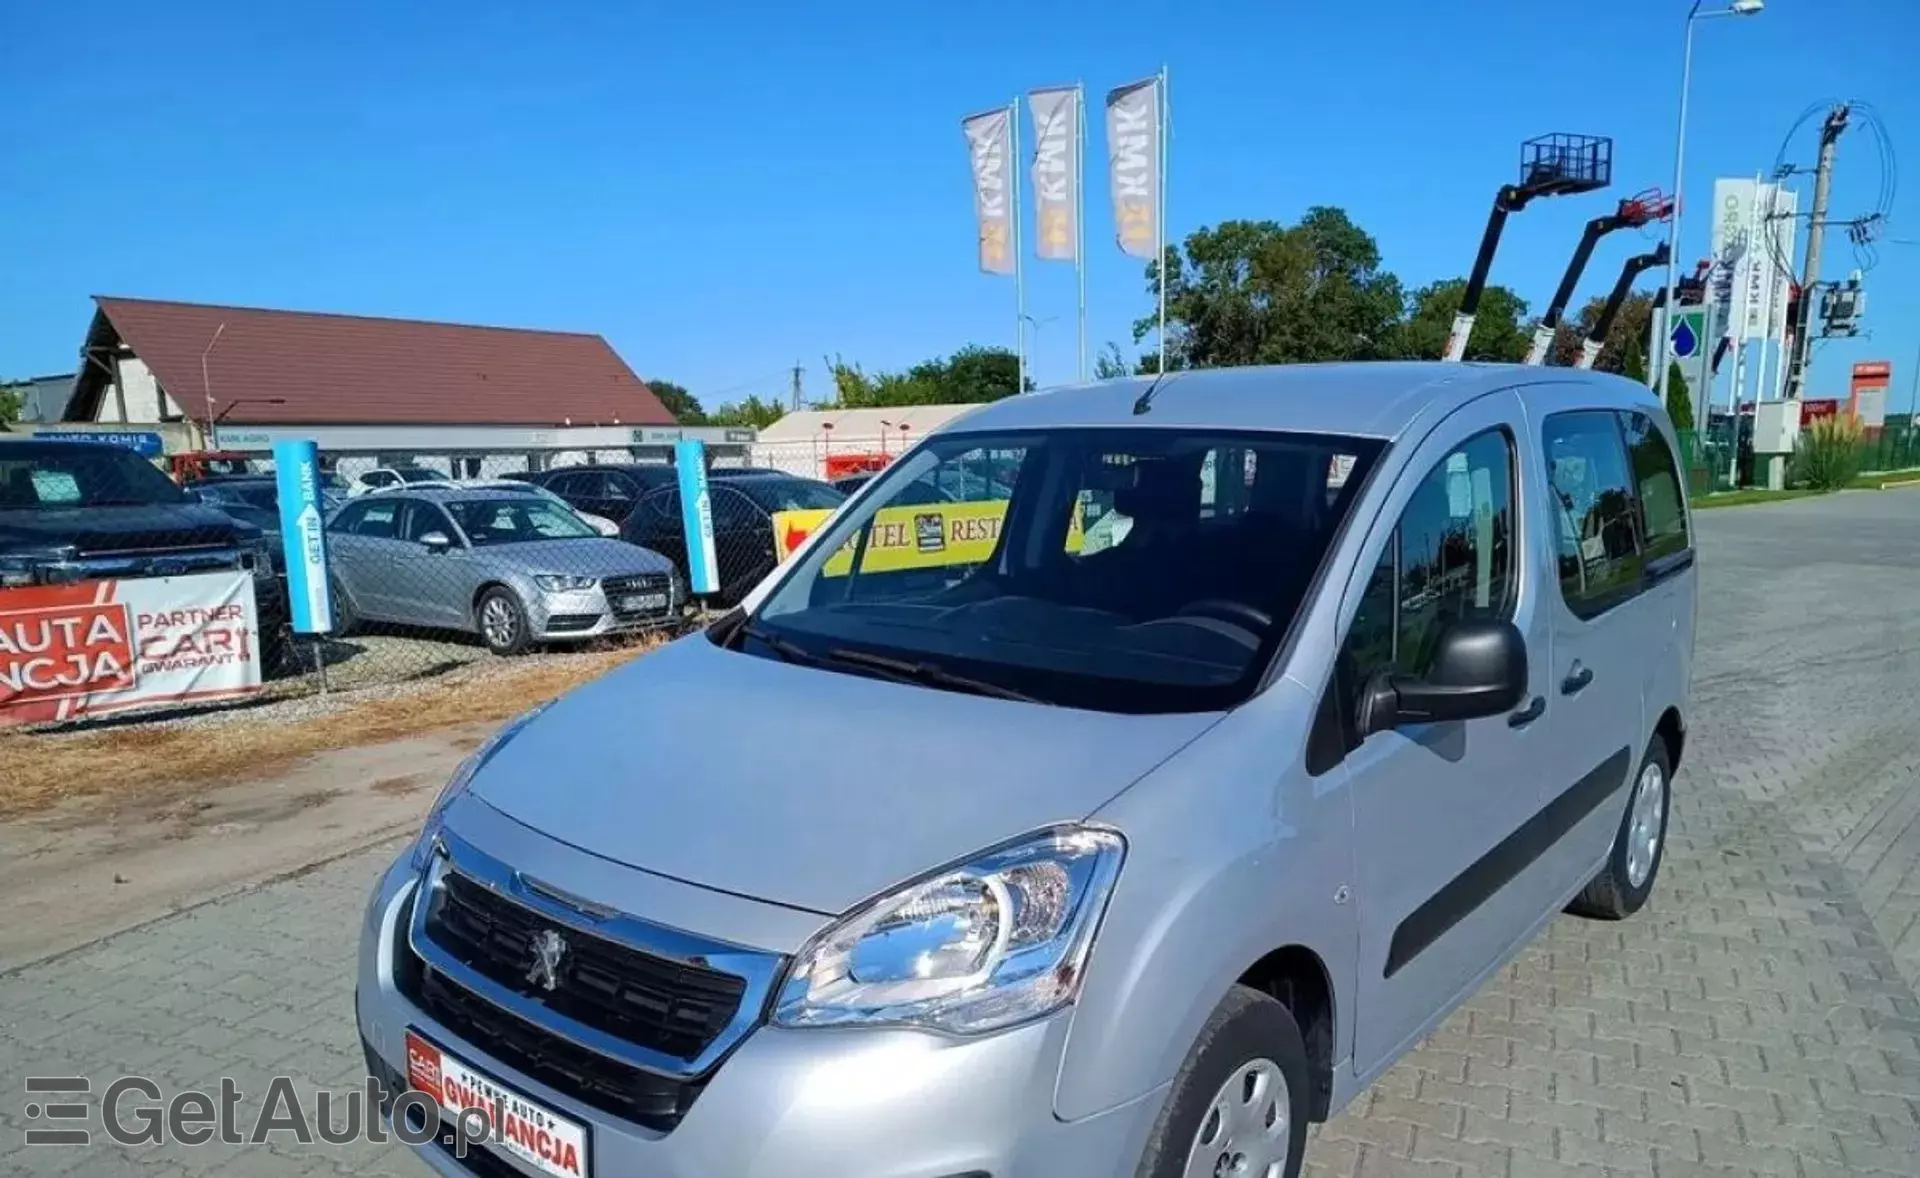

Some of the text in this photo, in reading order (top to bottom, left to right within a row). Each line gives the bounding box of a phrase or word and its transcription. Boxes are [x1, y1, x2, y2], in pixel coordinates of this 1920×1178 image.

[300, 460, 321, 564] GET IN BANK
[0, 614, 123, 654] AUTA
[137, 604, 242, 630] PARTNER
[511, 1099, 545, 1128] AUTO
